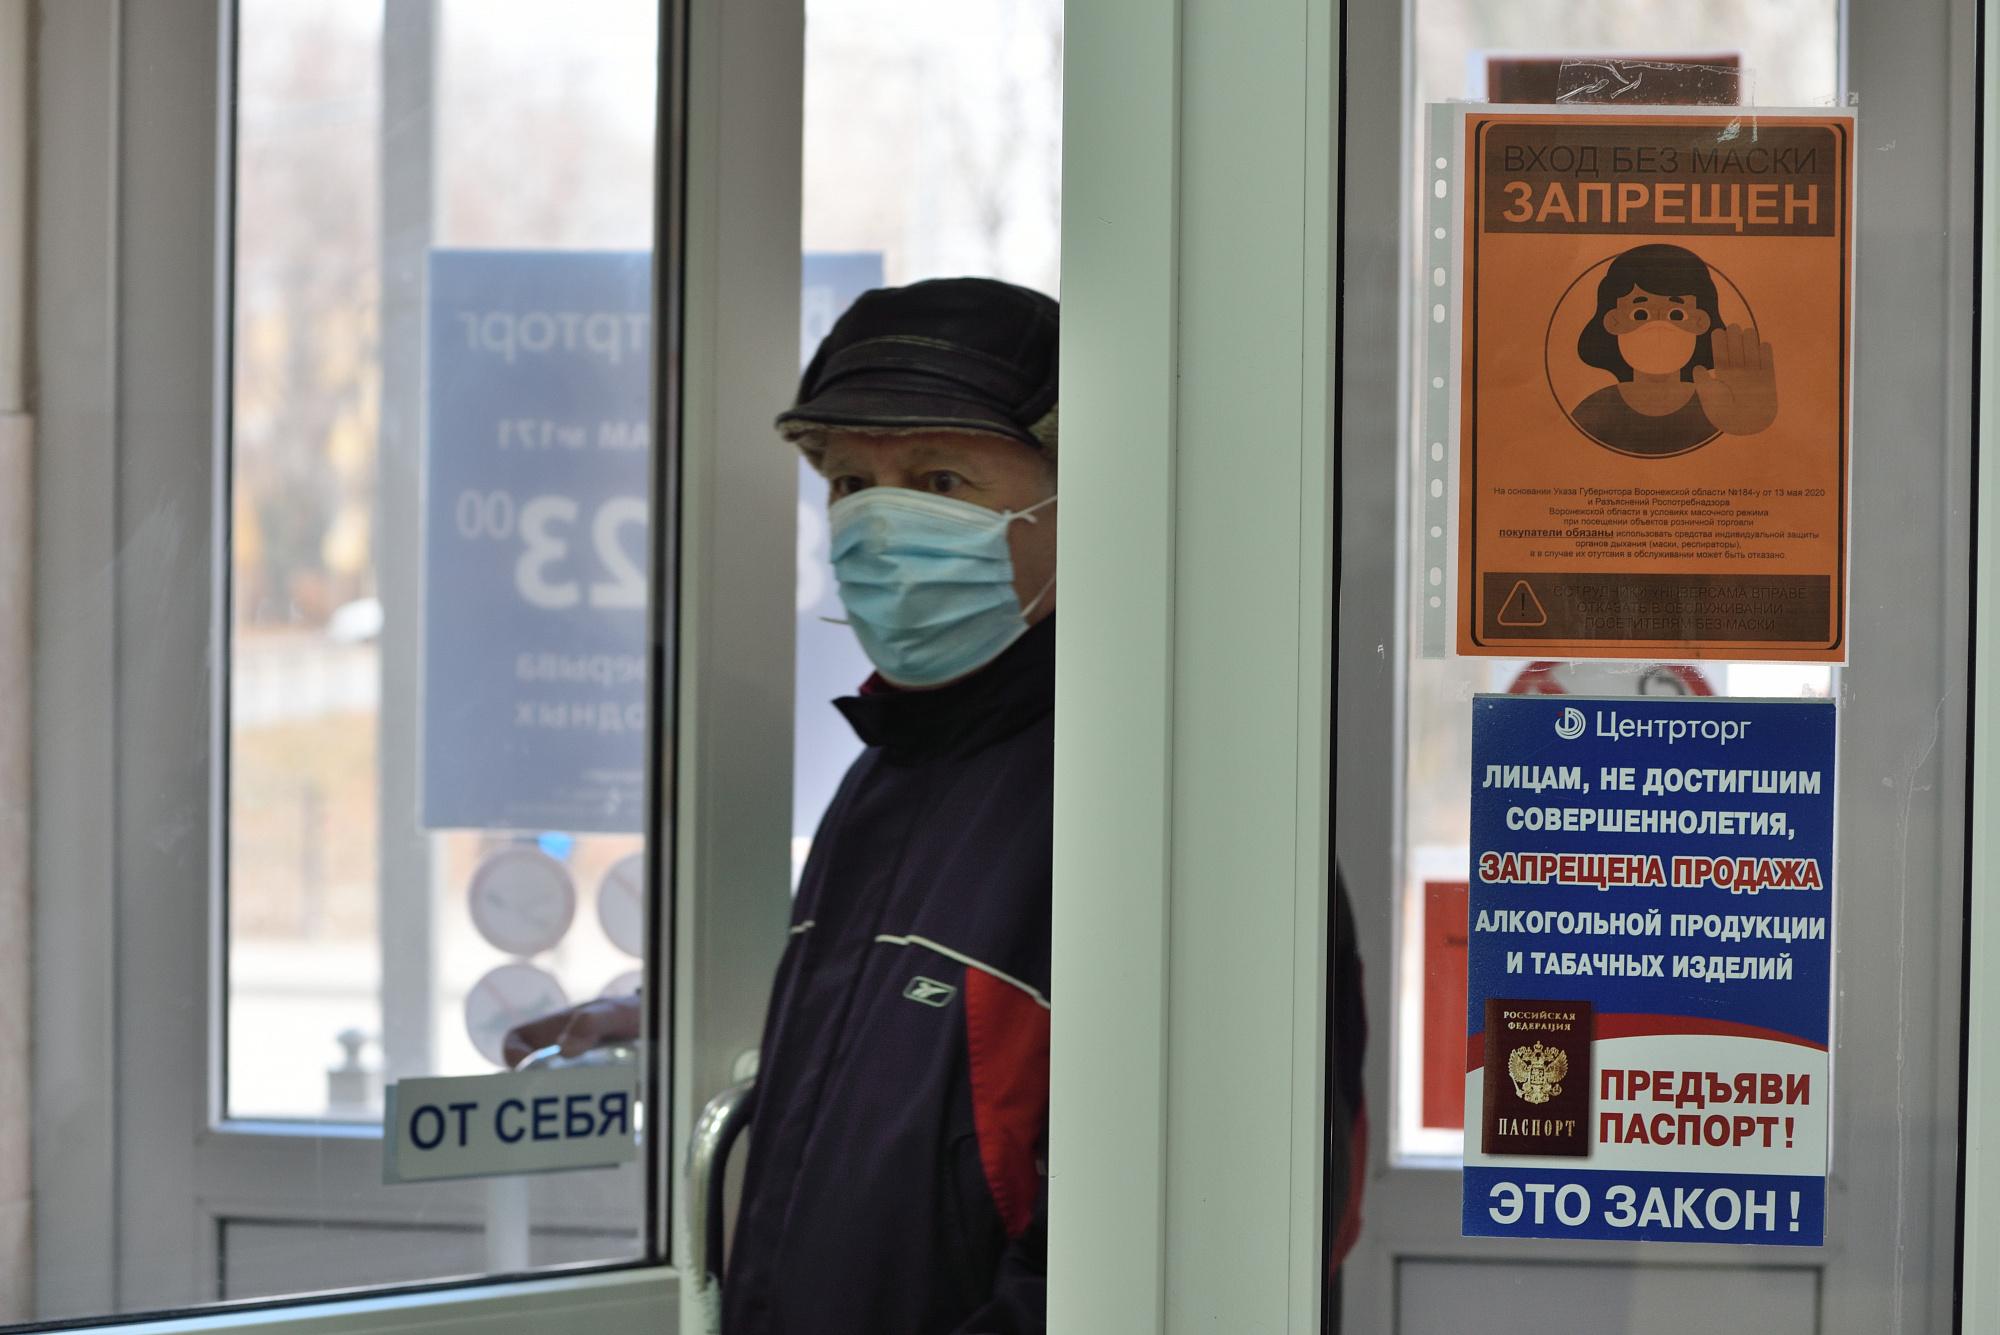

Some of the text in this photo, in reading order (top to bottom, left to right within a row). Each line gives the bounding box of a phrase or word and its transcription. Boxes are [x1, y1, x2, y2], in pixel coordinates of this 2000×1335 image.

[1503, 145, 1817, 178] ВХОД БЕЗ МАСКИ
[1502, 180, 1818, 233] ЗАПРЕЩЕН
[1493, 487, 1506, 496] На
[1507, 487, 1551, 496] основании
[1553, 487, 1577, 496] Указа
[1634, 488, 1690, 497] Воронежской
[1691, 488, 1726, 497] области
[1775, 488, 1785, 497] 13
[1805, 488, 1826, 497] 2020
[1595, 498, 1650, 507] Разъяснений
[1652, 498, 1730, 507] Роспотребнадзора
[1549, 507, 1605, 517] Воронежской
[1606, 507, 1641, 517] области
[1649, 508, 1689, 517] условиях
[1690, 509, 1734, 517] масочного
[1736, 509, 1769, 518] режима
[1581, 518, 1628, 526] посещении
[1630, 517, 1669, 526] объектов
[1670, 517, 1715, 526] розничной
[1717, 519, 1754, 527] торговли
[1499, 528, 1563, 538] покупатели
[1565, 527, 1614, 538] обязаны
[1615, 530, 1673, 538] использовать
[1674, 530, 1713, 538] средства
[1575, 540, 1609, 549] органов
[1610, 540, 1647, 549] дыхания
[1544, 551, 1573, 560] случае
[1633, 549, 1694, 560] обслуживании
[1696, 551, 1723, 559] может
[1724, 550, 1746, 559] быть
[1596, 710, 1752, 746] Центрторг
[1482, 764, 1821, 796] ЛИЦАМ, НЕ ДОСТИГШИМ
[1505, 806, 1795, 841] СОВЕРШЕННОЛЕТИЯ,
[1479, 851, 1823, 894] ЗАПРЕЩЕНА ПРОДАЖА
[1474, 908, 1825, 944] АЛКОГОЛЬНОЙ ПРОДУКЦИИ
[1507, 952, 1793, 984] И ТАБАЧНЫХ ИЗДЕЛИЙ
[1503, 1011, 1576, 1021] РОССИЙСКАЯ
[1507, 1021, 1571, 1032] ФЕДЕРАЦИЯ
[1600, 1069, 1810, 1110] ПРЕДЪЯВИ
[409, 1091, 629, 1150] ОТ СЕБЯ
[1498, 1118, 1576, 1137] ПАСПОРТ
[1599, 1112, 1794, 1149] ПАСПОРТ!
[1488, 1181, 1591, 1227] ЭТО
